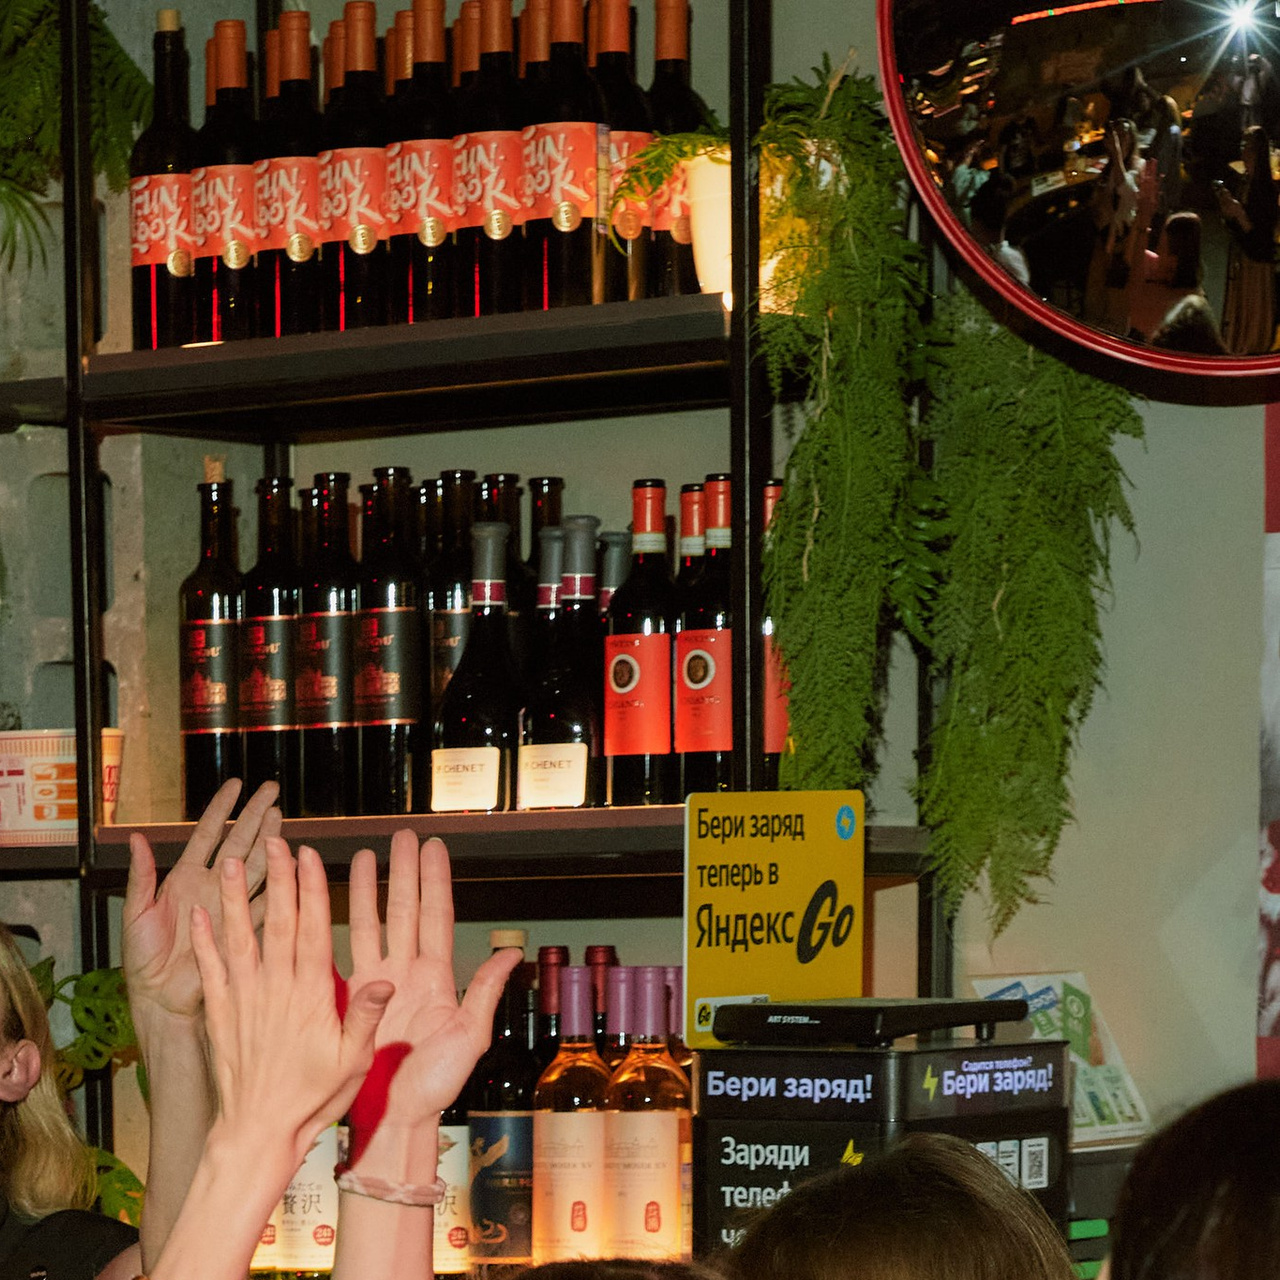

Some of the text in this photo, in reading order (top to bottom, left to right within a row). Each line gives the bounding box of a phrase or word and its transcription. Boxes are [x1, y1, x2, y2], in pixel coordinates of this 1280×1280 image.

[697, 807, 805, 844] Бери заряд
[697, 862, 779, 892] теперь в
[696, 879, 854, 964] Яндекс Go
[707, 1071, 873, 1104] Бери заряд!
[942, 1063, 1053, 1099] Бери заряд!
[720, 1136, 810, 1170] Заряди
[720, 1181, 792, 1208] теле
